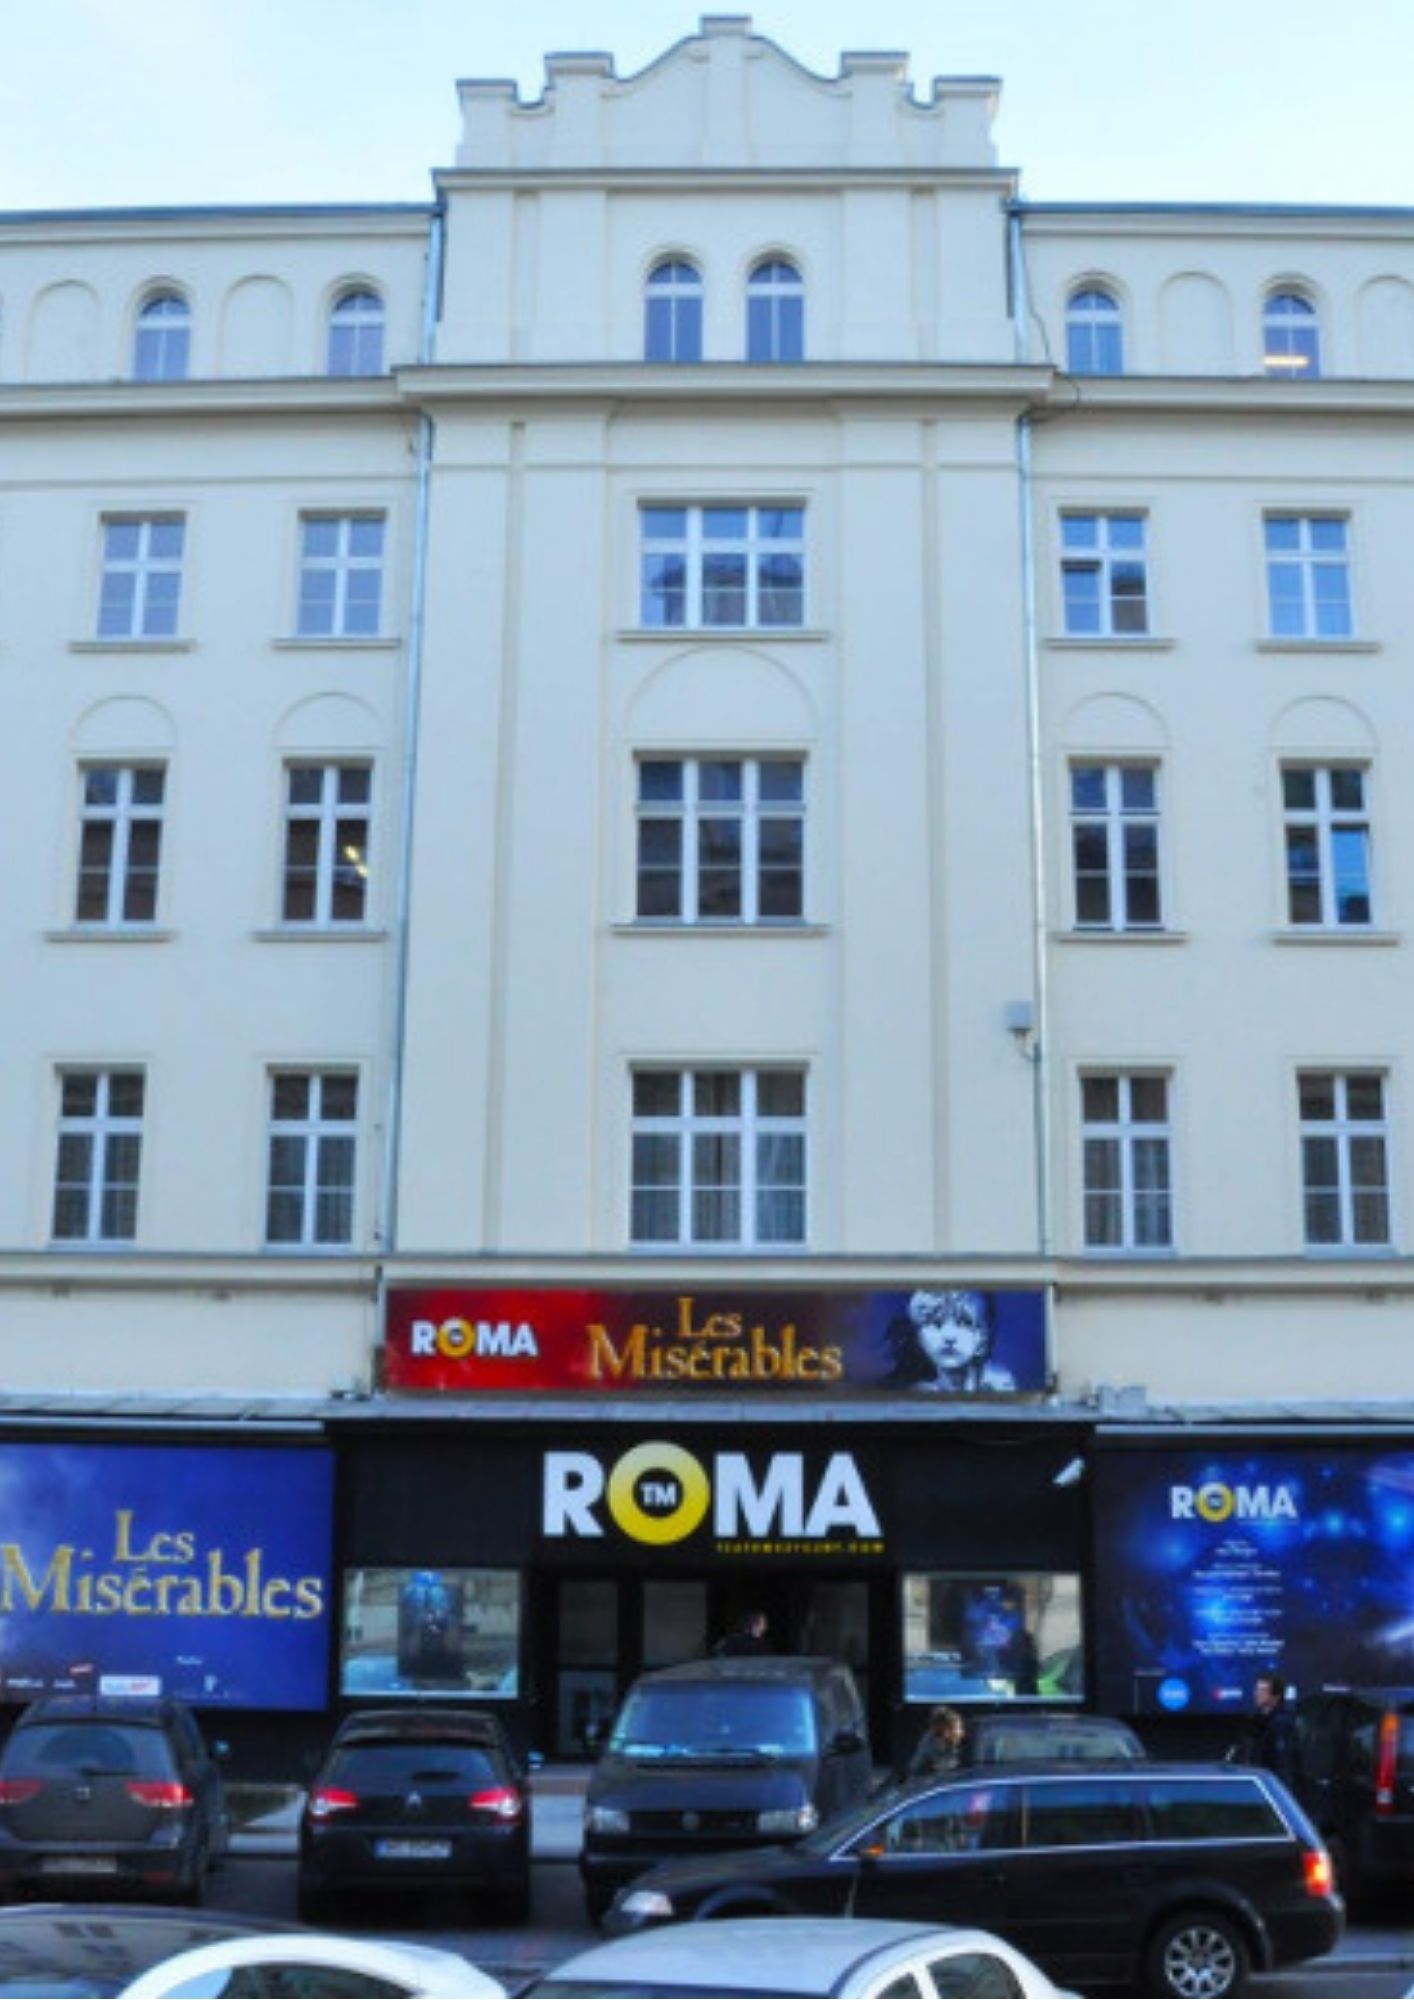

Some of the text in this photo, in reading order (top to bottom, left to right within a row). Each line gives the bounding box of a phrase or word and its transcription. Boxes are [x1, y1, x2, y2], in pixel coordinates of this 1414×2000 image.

[411, 1317, 538, 1357] ROMA
[677, 1297, 742, 1338] Les
[586, 1323, 842, 1380] Misérables
[543, 1440, 882, 1545] ROMA
[641, 1482, 676, 1506] TM
[1171, 1483, 1298, 1523] ROMA
[114, 1510, 195, 1562] Les
[0, 1543, 324, 1618] Misérables
